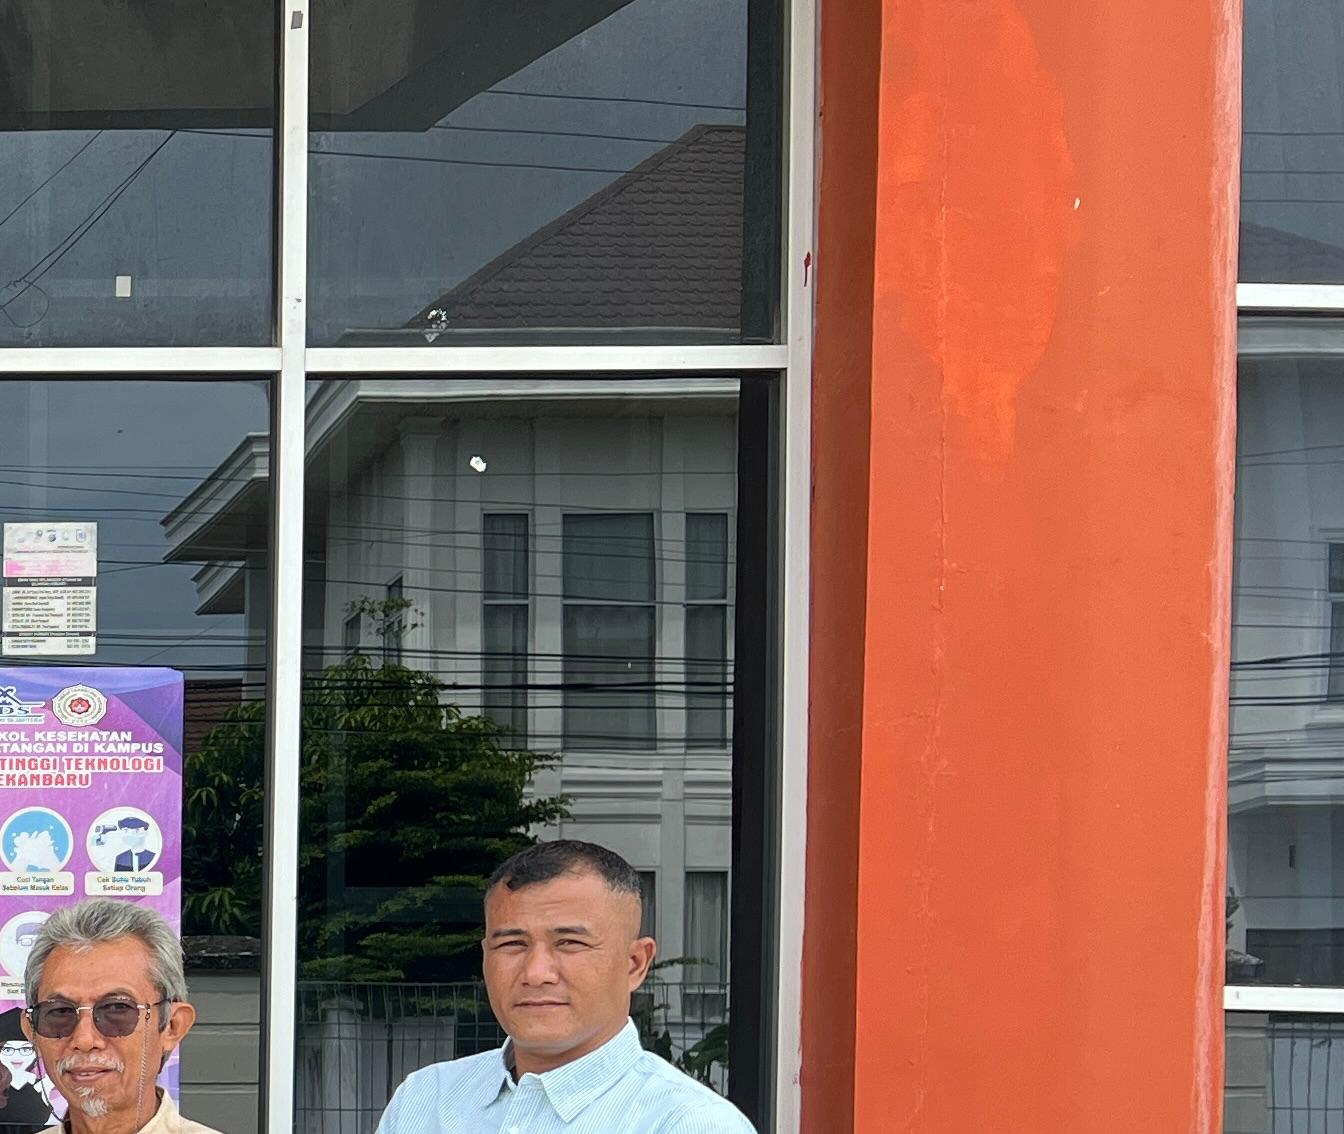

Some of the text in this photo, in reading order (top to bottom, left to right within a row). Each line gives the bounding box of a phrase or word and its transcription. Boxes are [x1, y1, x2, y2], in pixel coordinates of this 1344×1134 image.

[35, 731, 132, 742] KESEHATAN
[73, 743, 90, 753] DI
[96, 743, 164, 753] KAMPUS
[64, 758, 161, 771] TEKNOLOGI
